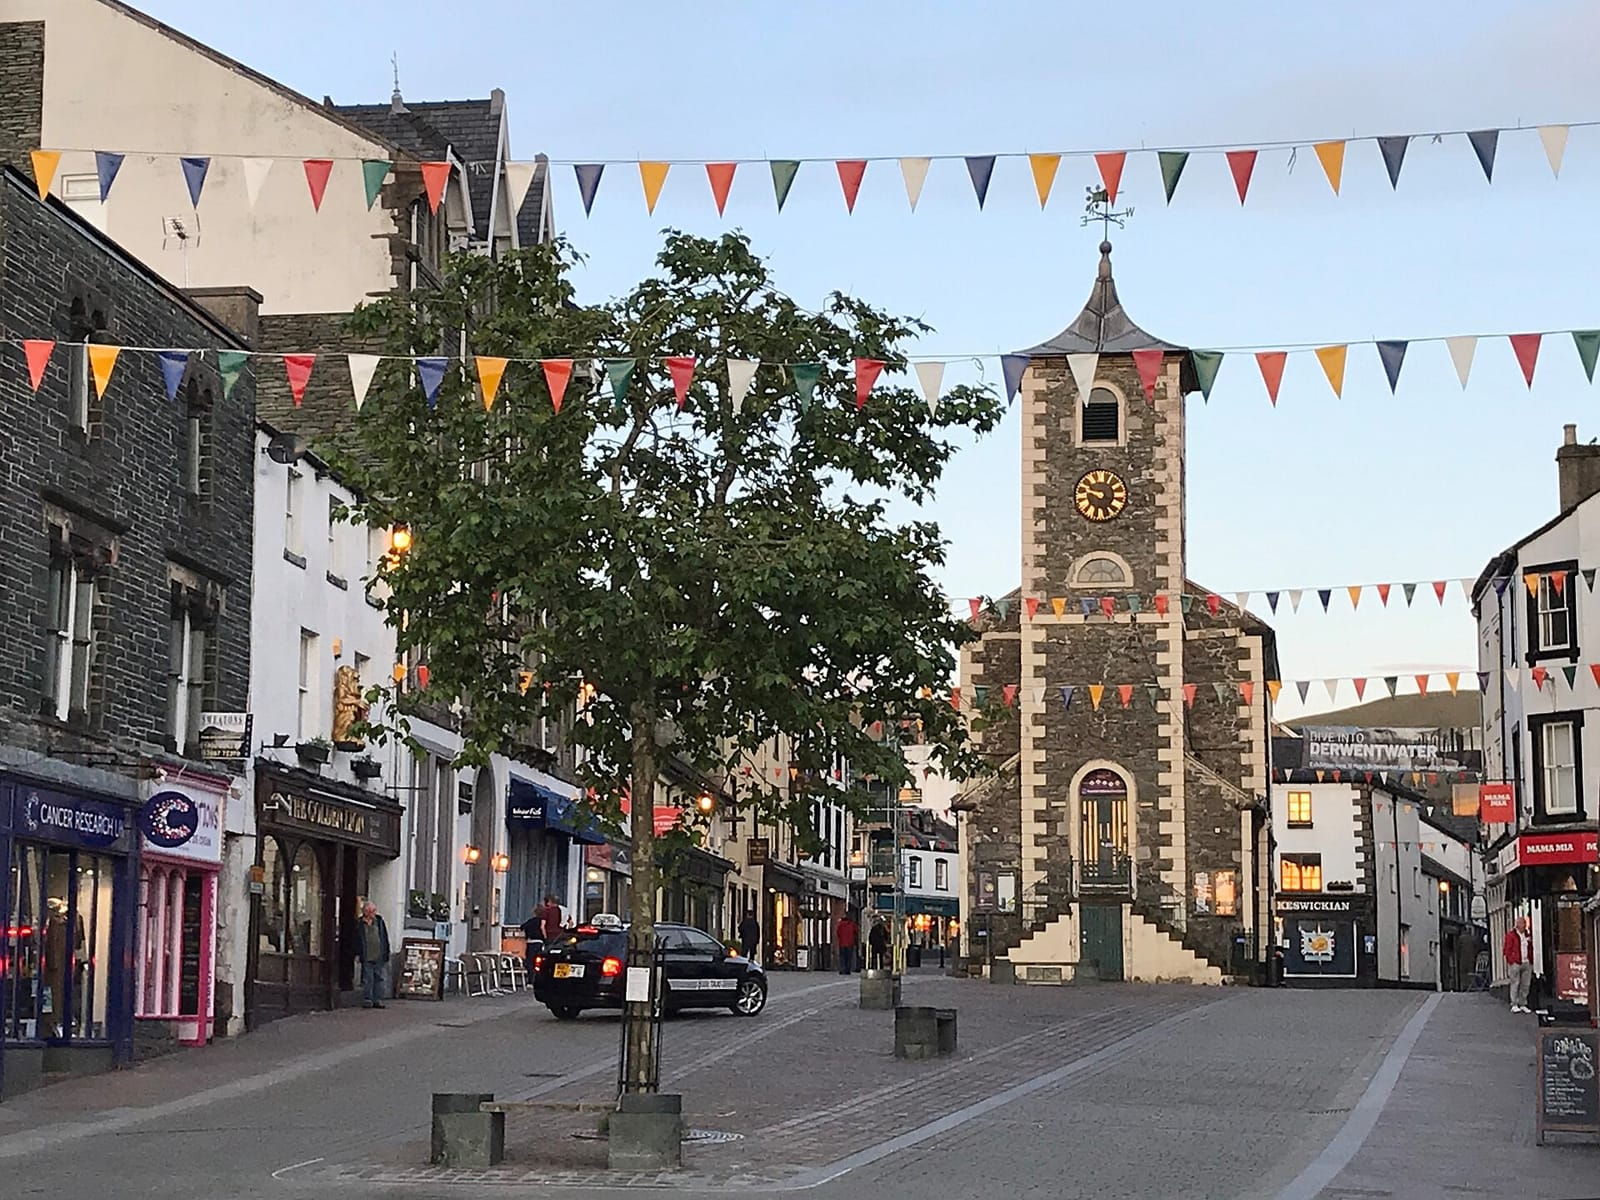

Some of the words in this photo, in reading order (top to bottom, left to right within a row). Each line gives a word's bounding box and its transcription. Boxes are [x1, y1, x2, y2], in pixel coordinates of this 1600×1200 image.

[1310, 731, 1334, 741] DIVE
[1337, 732, 1363, 743] INTO
[1310, 744, 1438, 758] DERWENTWATER
[40, 804, 72, 829] CANCER
[74, 811, 114, 837] RESEARCH
[1526, 845, 1554, 854] MAMA
[1555, 844, 1574, 852] MIA
[1277, 901, 1350, 910] KESWICKIAN
